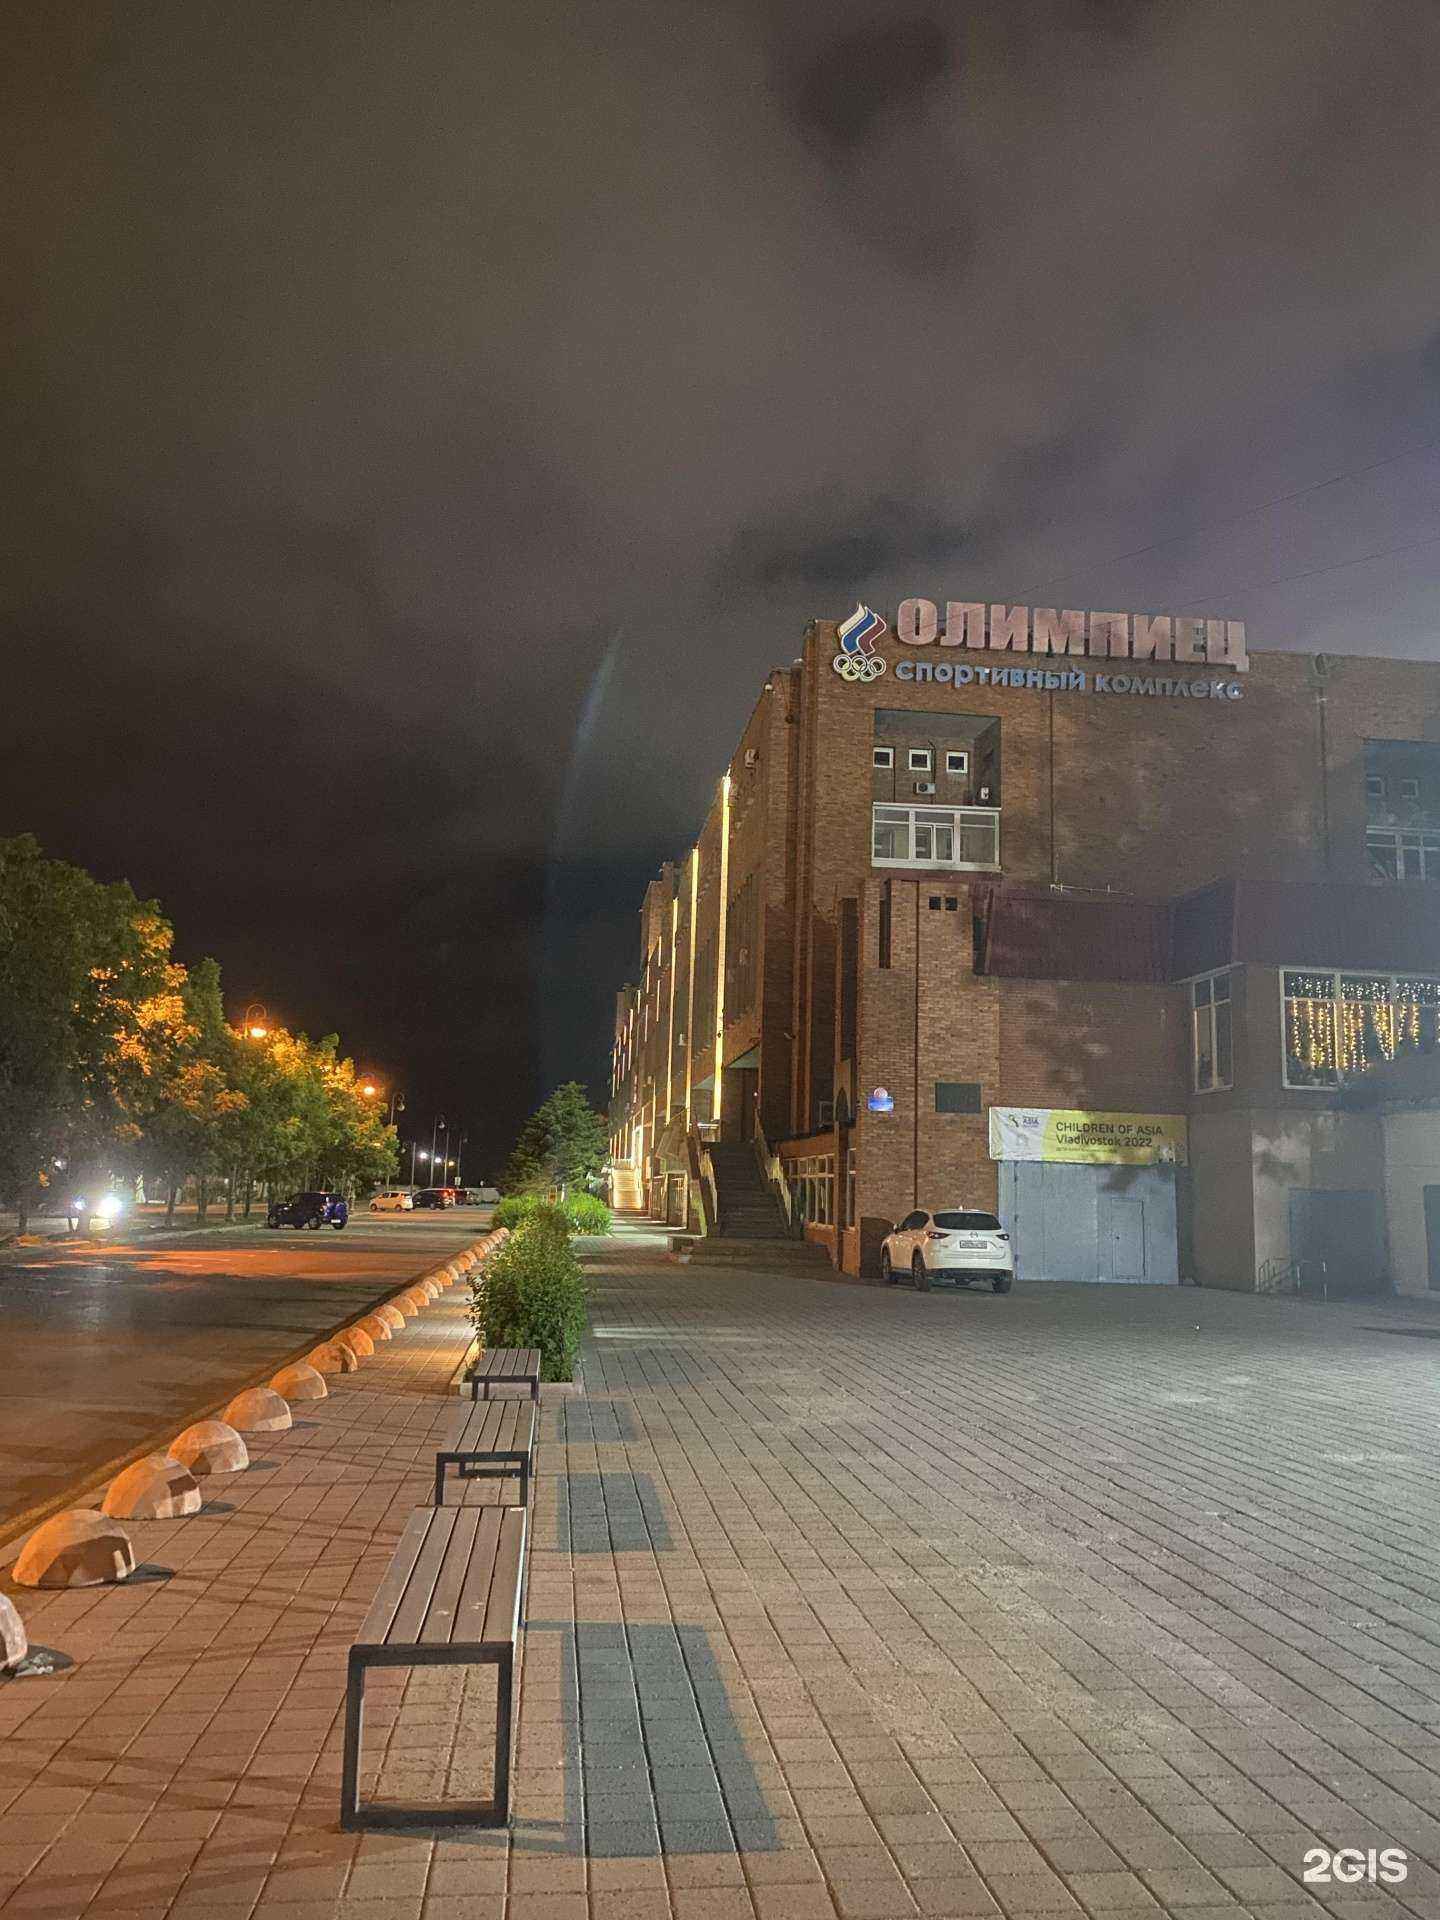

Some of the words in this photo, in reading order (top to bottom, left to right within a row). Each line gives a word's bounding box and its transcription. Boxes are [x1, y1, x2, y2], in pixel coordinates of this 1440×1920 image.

[897, 598, 1249, 672] ОЛИМПИЕЦ
[1056, 1121, 1114, 1134] CHILDREN
[1118, 1124, 1133, 1134] OF
[1136, 1125, 1163, 1136] ASIA
[1056, 1134, 1121, 1147] Vladivostok
[1125, 1137, 1153, 1148] 2022
